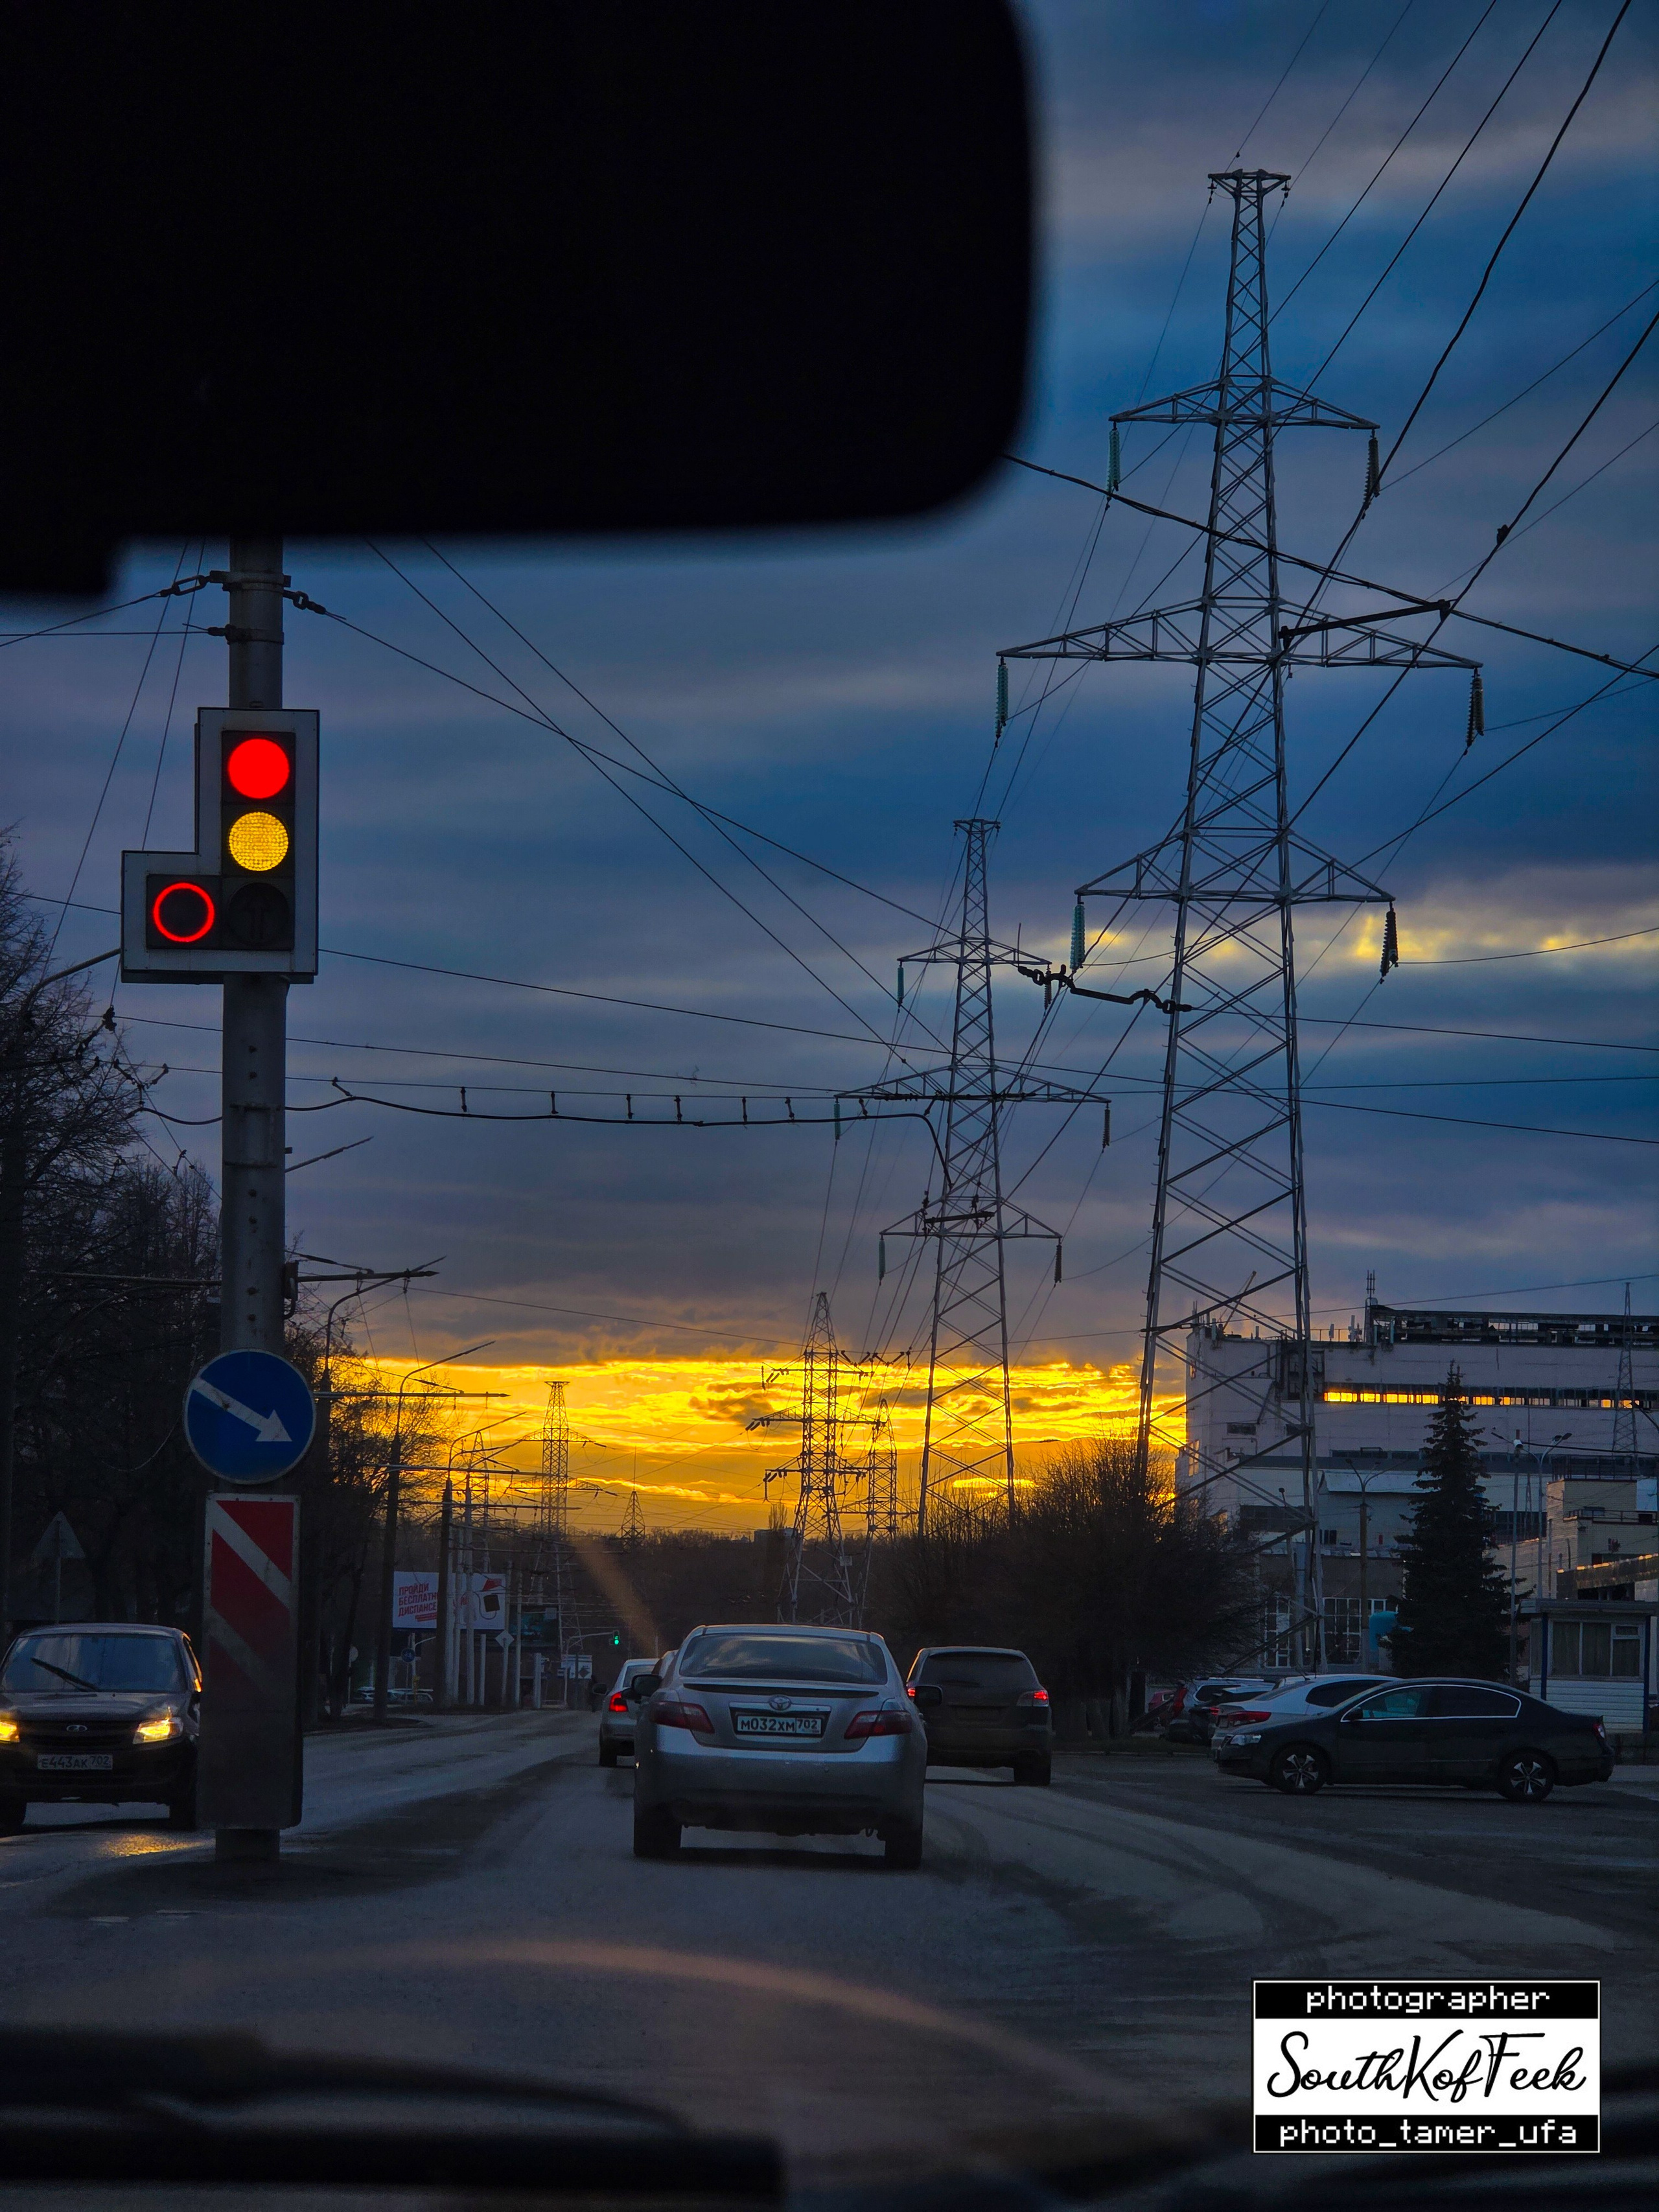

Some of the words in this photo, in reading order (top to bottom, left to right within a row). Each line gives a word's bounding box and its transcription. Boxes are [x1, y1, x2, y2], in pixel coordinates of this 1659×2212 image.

[399, 1583, 429, 1596] ПРОЙДИ
[399, 1592, 439, 1606] БЕСПЛАТН
[398, 1601, 437, 1617] ДИСПАНСЕ
